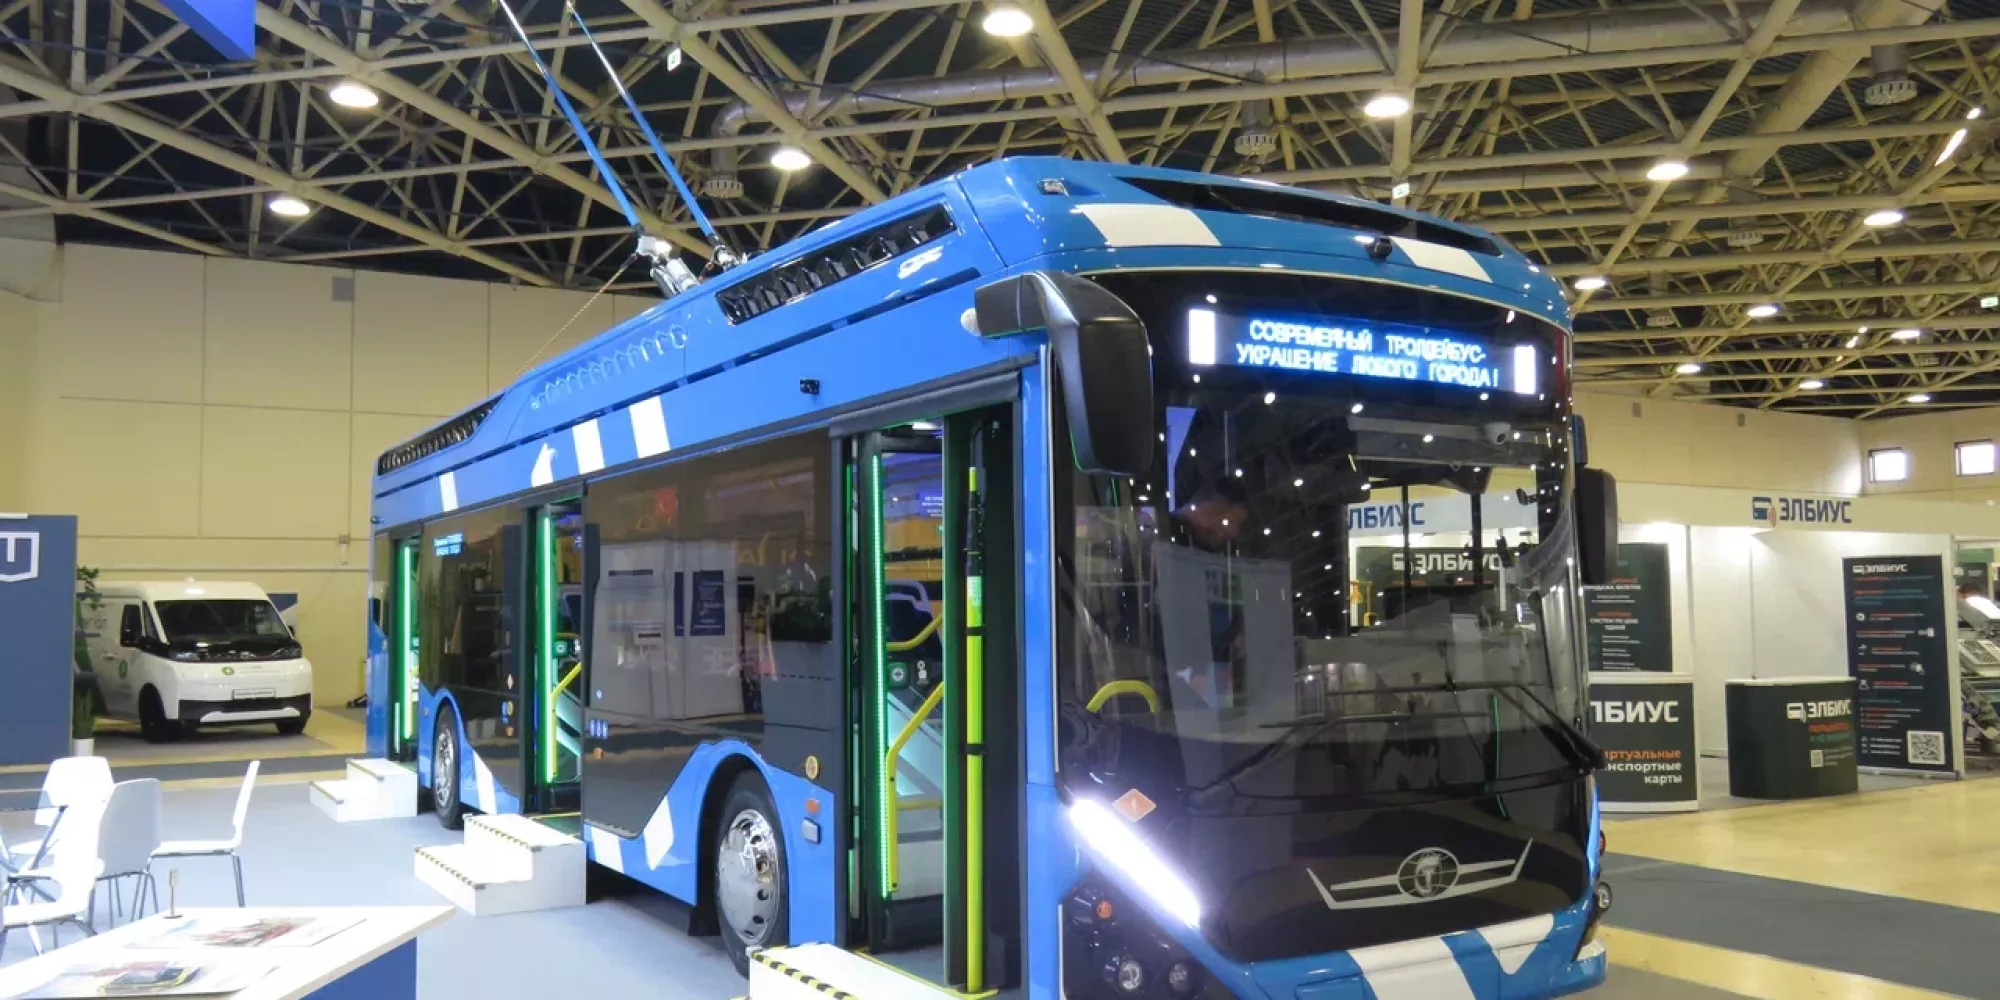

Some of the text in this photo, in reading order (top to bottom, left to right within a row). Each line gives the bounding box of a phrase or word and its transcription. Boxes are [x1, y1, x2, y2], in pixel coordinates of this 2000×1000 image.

[1235, 342, 1339, 372] УКРАШЕНИЕ
[1351, 354, 1417, 379] ЛЮБОГО
[1348, 503, 1425, 530] ЛБИУС
[1778, 497, 1852, 524] ЭЛБИУС
[1590, 700, 1679, 723] ЛБИУС
[1807, 699, 1851, 718] ЭЛБИУС
[1604, 750, 1682, 761] ртуальные
[1604, 762, 1682, 773] нспортные
[1644, 775, 1682, 786] карты
